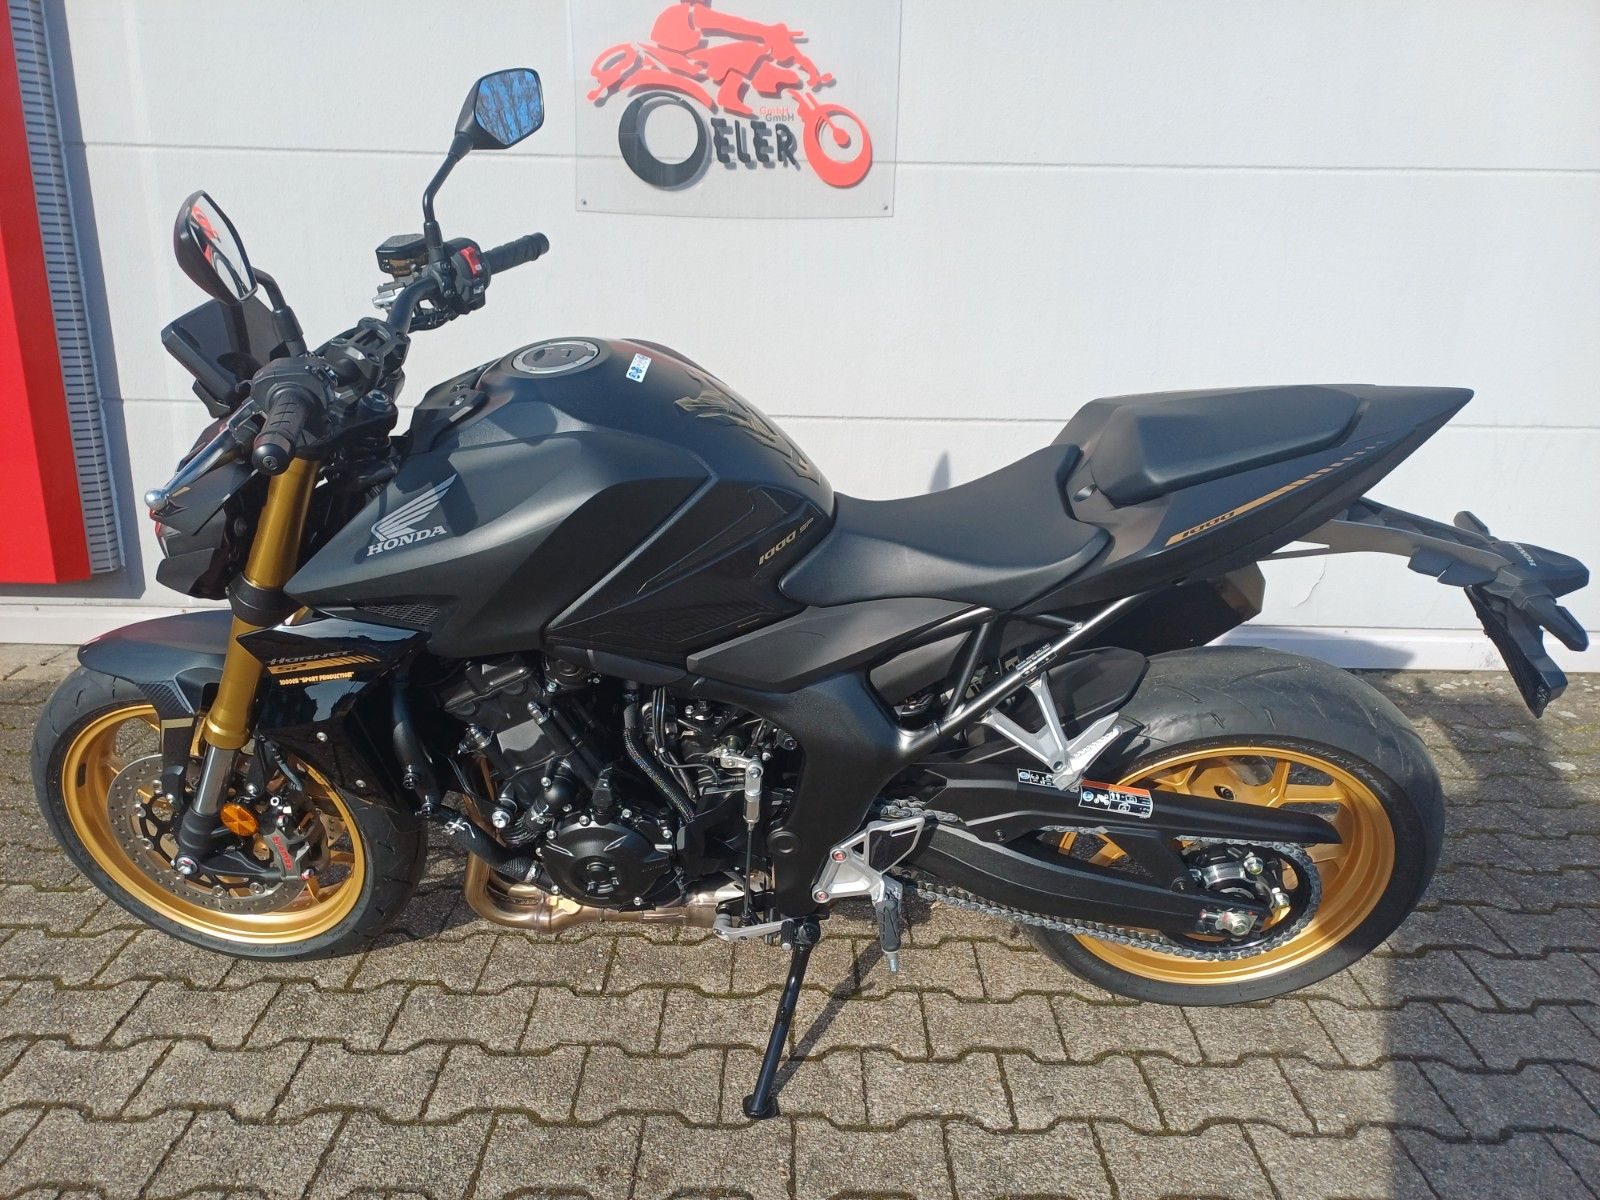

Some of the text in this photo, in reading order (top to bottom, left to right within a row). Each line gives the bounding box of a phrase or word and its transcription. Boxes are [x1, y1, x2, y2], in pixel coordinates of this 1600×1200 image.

[1182, 511, 1234, 538] 1000
[366, 525, 447, 556] HONDA
[759, 530, 797, 566] 1000
